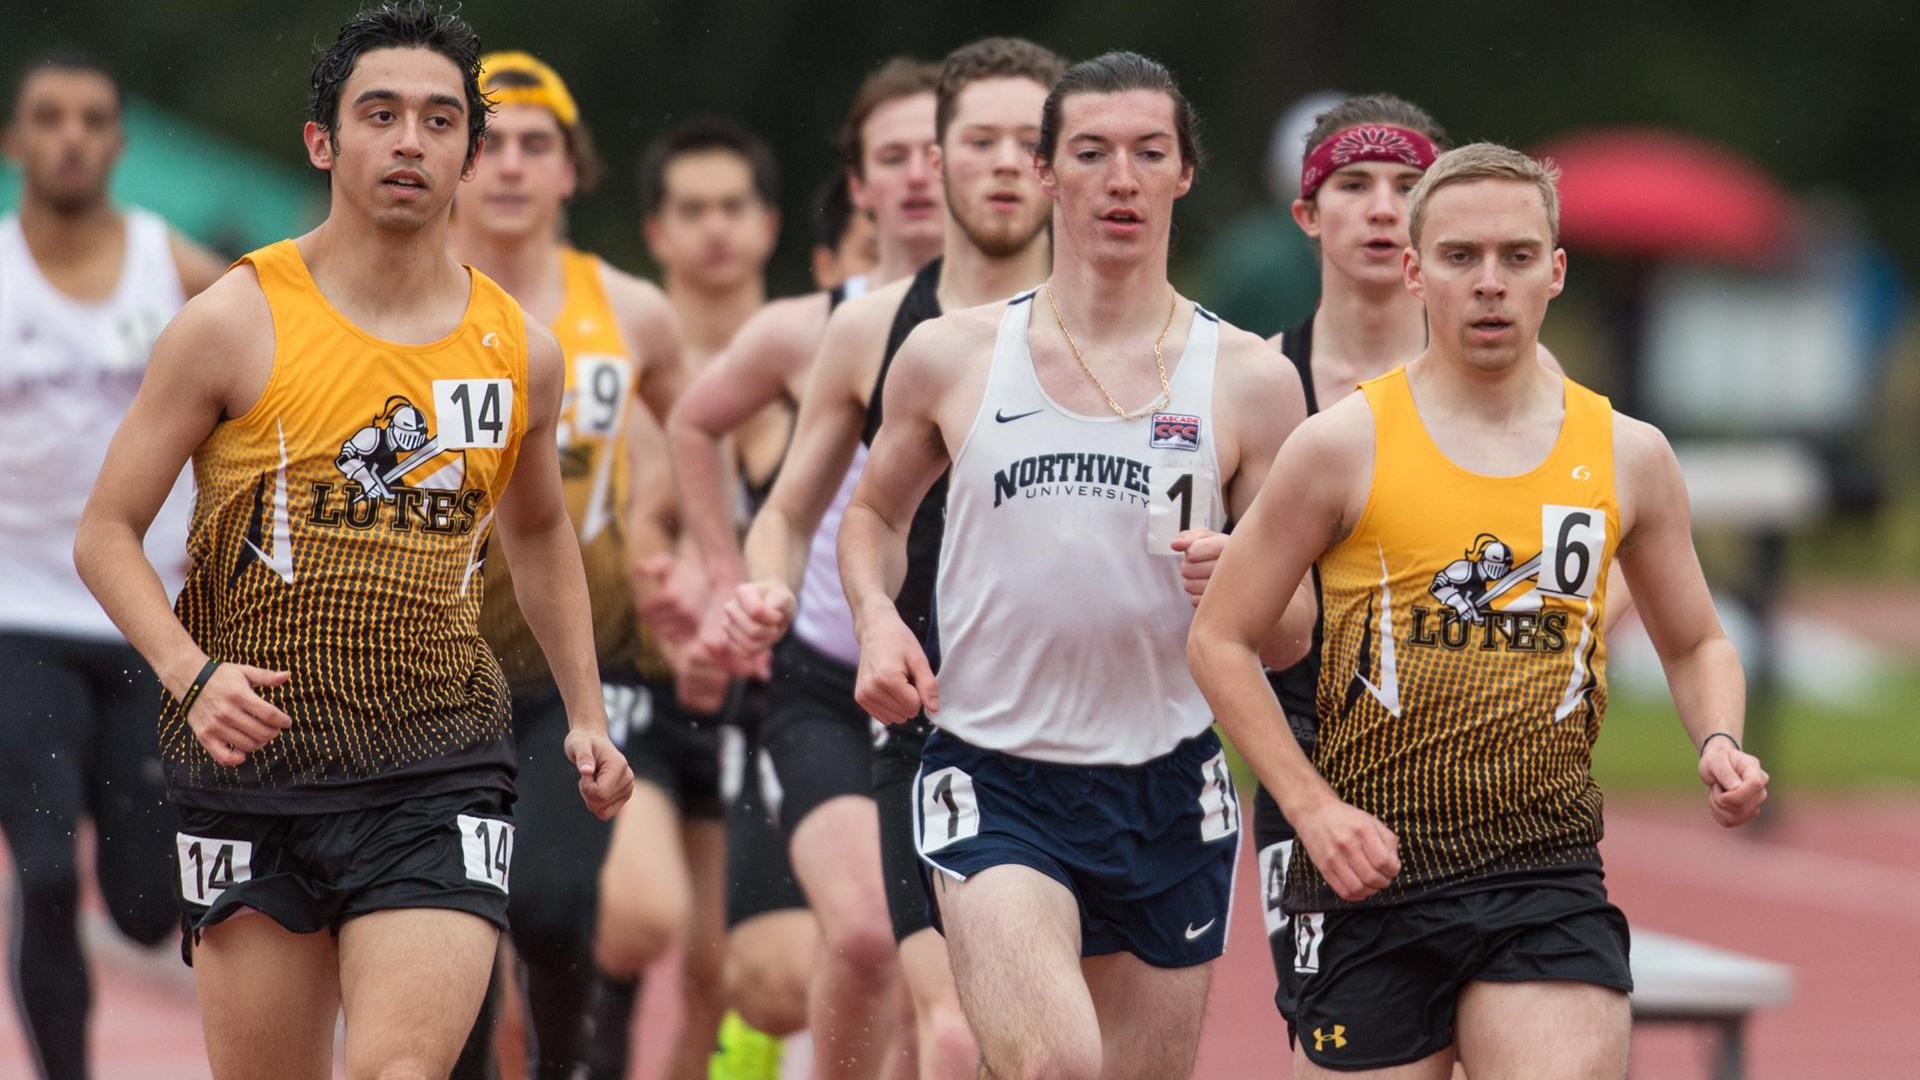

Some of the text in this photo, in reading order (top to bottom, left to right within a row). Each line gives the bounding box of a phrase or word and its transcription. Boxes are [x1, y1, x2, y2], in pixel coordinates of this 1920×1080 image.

[450, 383, 503, 443] 14
[593, 363, 620, 431] 9
[1155, 415, 1198, 424] CASCADE
[1155, 424, 1198, 439] CCC
[304, 482, 486, 535] LUTES
[994, 453, 1152, 508] NORTHWES
[1025, 485, 1150, 508] UNIVERSITY
[1166, 473, 1193, 532] 1
[1555, 512, 1591, 594] 6
[1408, 605, 1568, 653] LUTES
[932, 773, 960, 840] 1
[187, 841, 239, 900] 14
[474, 821, 509, 886] 14
